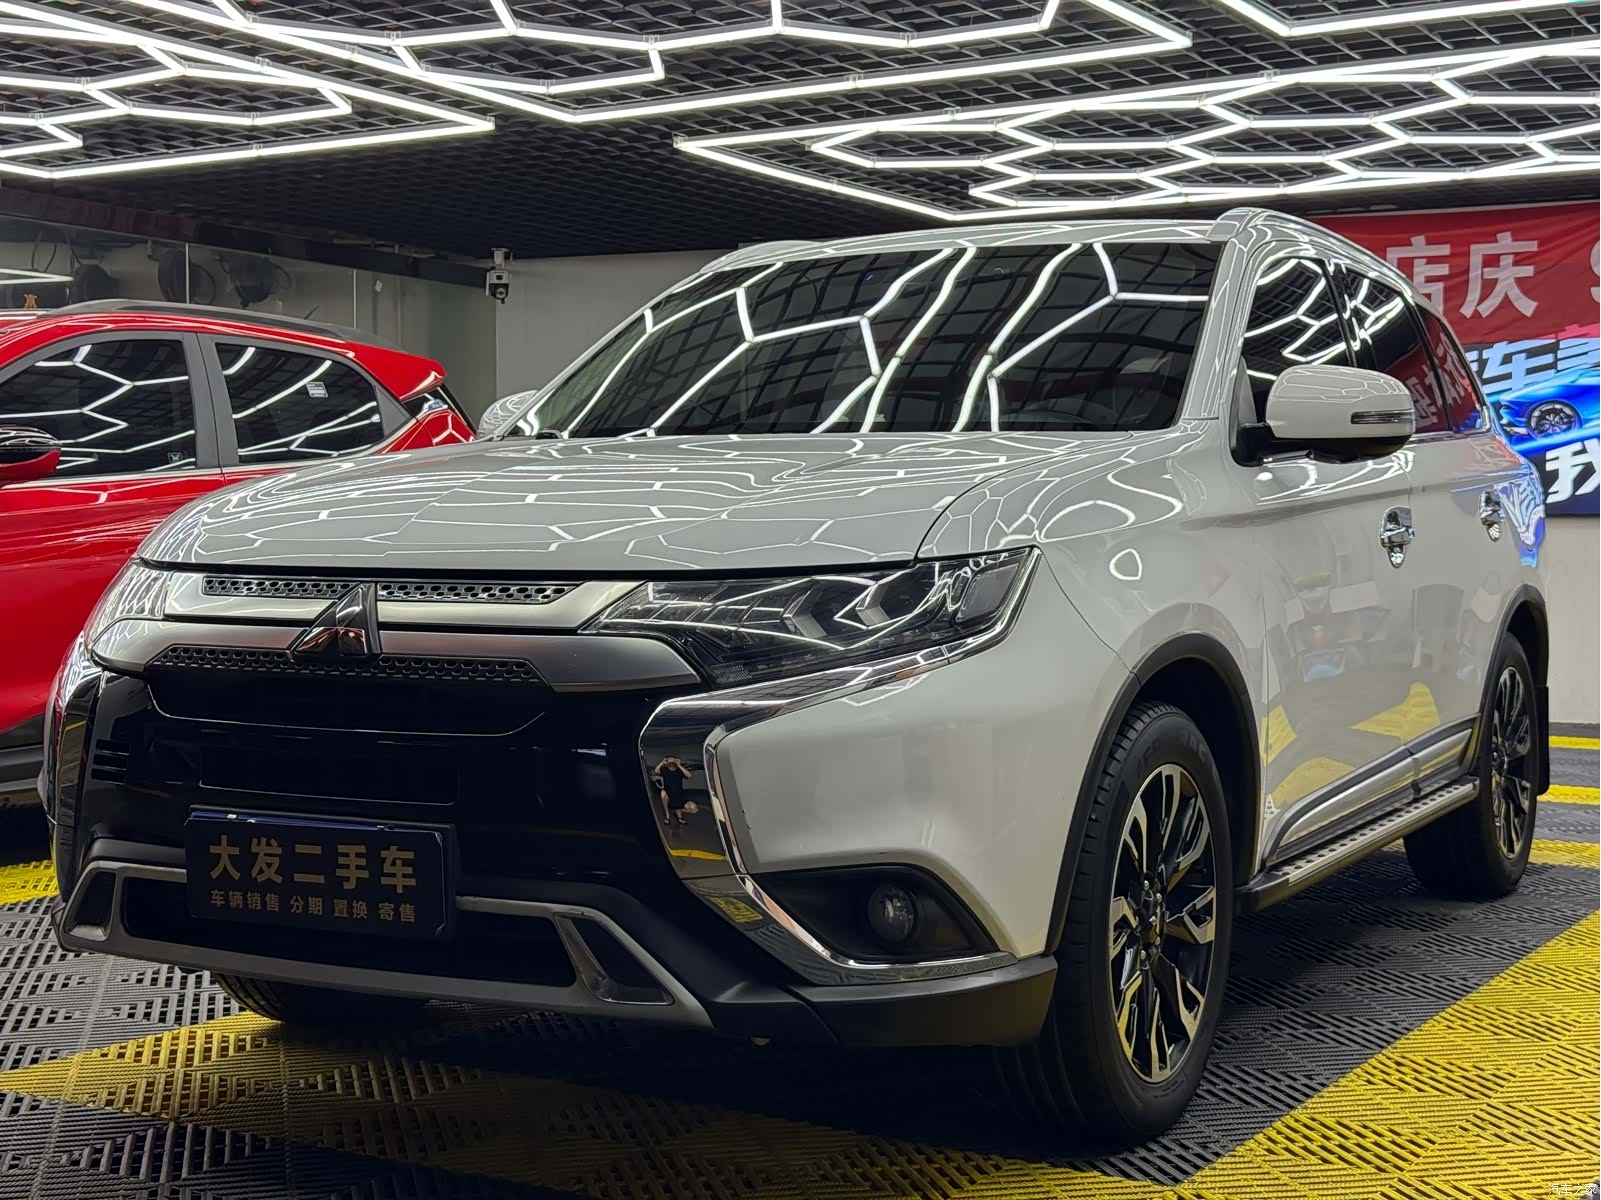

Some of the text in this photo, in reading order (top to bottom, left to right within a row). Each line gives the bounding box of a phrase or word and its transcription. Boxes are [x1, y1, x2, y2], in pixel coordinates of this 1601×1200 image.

[1386, 231, 1539, 318] 店庆
[209, 834, 417, 894] 大发二手车
[210, 889, 416, 923] 车辆销售 分期 置换 寄售
